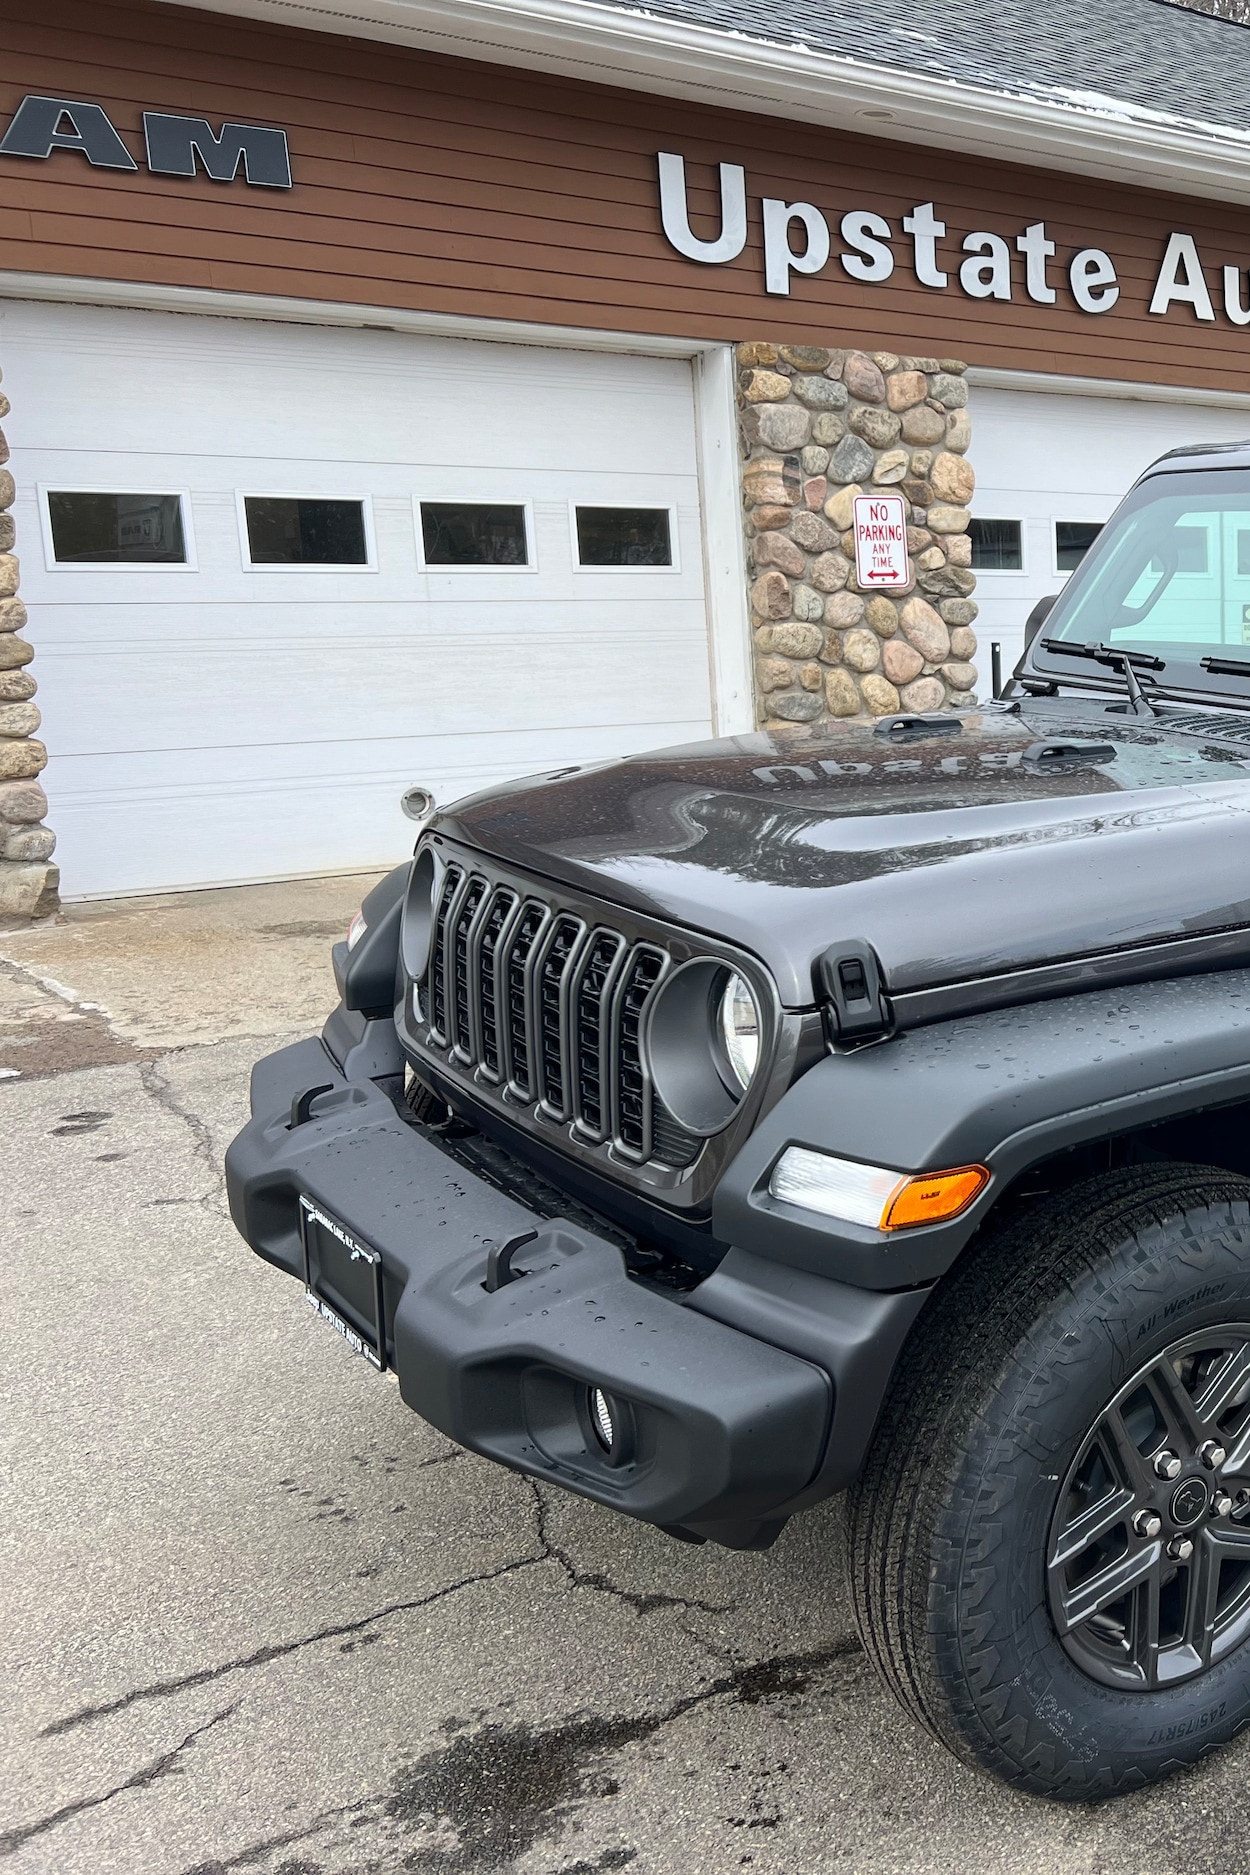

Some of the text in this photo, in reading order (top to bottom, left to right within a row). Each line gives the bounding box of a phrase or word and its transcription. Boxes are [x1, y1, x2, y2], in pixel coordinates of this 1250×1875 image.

[656, 152, 1120, 315] Upstate
[870, 505, 888, 521] NO
[859, 525, 902, 541] PARKING
[872, 543, 891, 554] ANY
[872, 557, 894, 568] TIME
[1135, 1281, 1229, 1341] All-Weather
[321, 1302, 346, 1337] UPSTATE
[346, 1328, 363, 1353] AUTO
[1146, 1699, 1228, 1747] 245/75R17
